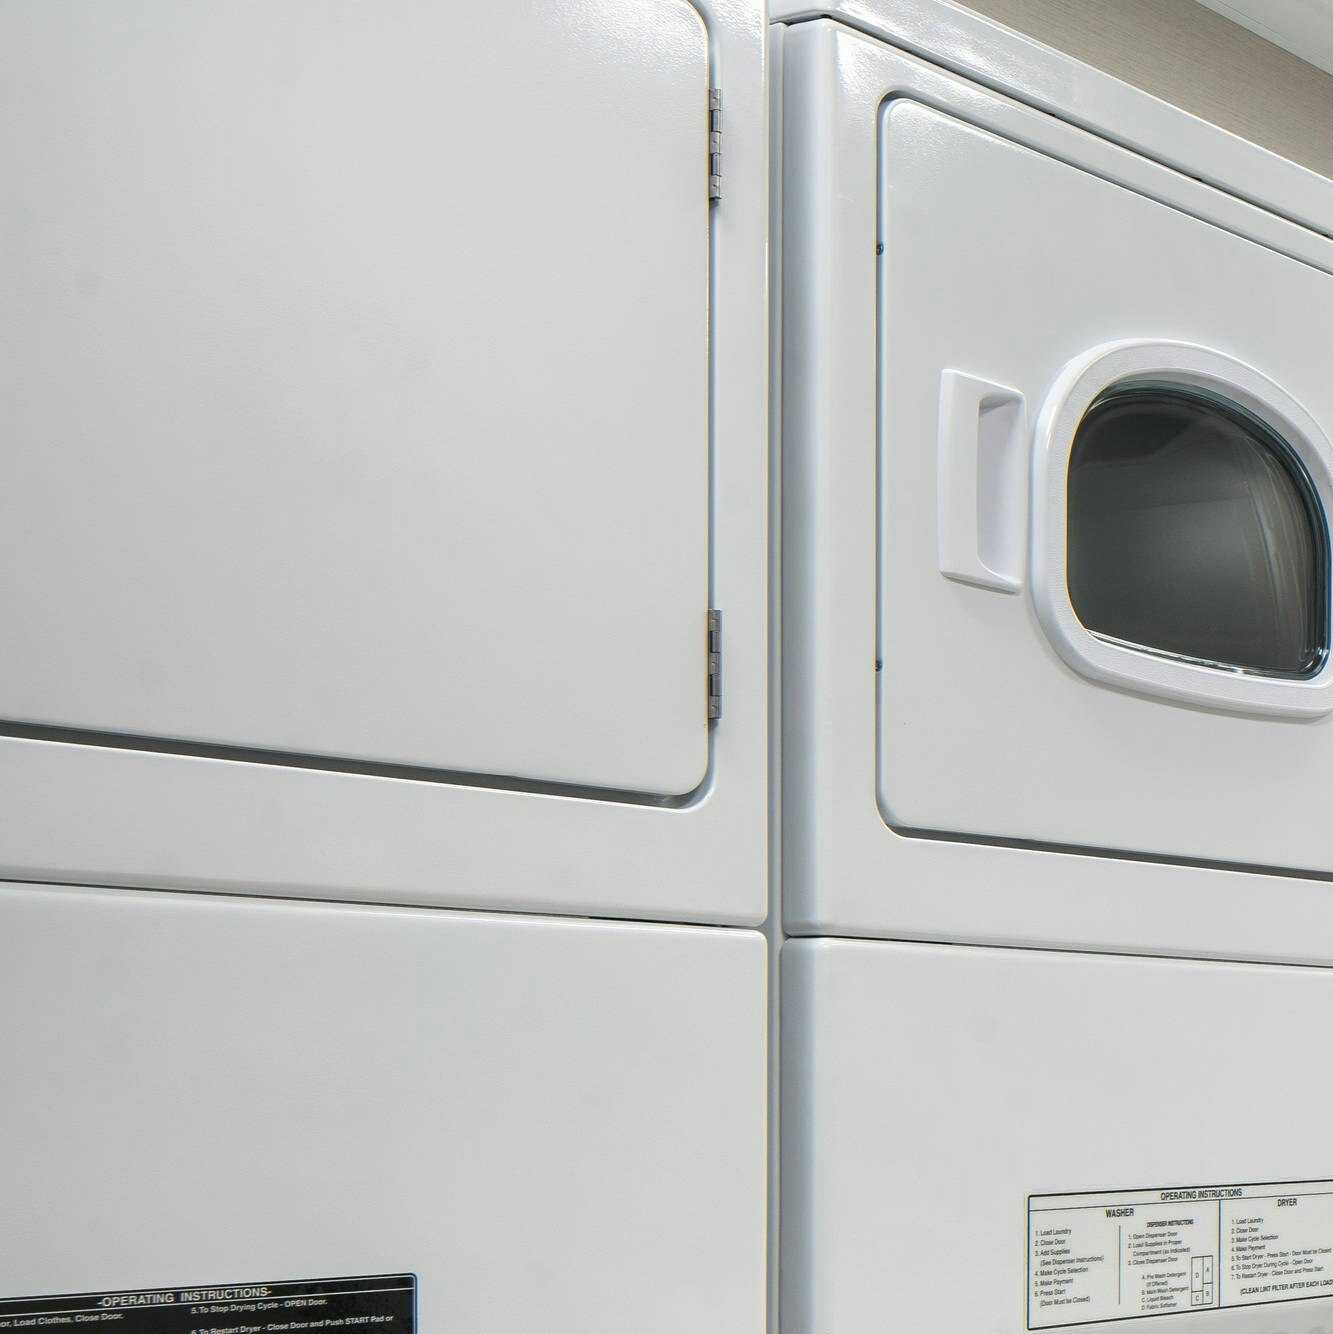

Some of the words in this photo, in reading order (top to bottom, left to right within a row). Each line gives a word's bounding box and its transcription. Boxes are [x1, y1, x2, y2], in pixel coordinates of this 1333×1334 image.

[1160, 1190, 1197, 1200] OPERATING
[1197, 1188, 1242, 1198] INSTRUCTIONS
[1277, 1197, 1297, 1206] DRYER
[1105, 1208, 1134, 1217] WASHER
[97, 1293, 174, 1306] -OPERATING
[180, 1287, 272, 1301] INSTRUCTIONS-
[198, 1305, 209, 1313] To
[209, 1305, 229, 1313] Stop
[229, 1303, 256, 1312] Drying
[256, 1301, 279, 1310] Cycle
[283, 1299, 307, 1307] OPEN
[307, 1298, 328, 1306] Door.
[13, 1318, 36, 1326] Load
[37, 1316, 74, 1324] Clothes.
[74, 1314, 100, 1322] Close
[239, 1325, 261, 1333] Dryer
[289, 1321, 309, 1329] Door
[309, 1319, 324, 1327] and
[324, 1318, 344, 1326] Push
[344, 1316, 370, 1324] START
